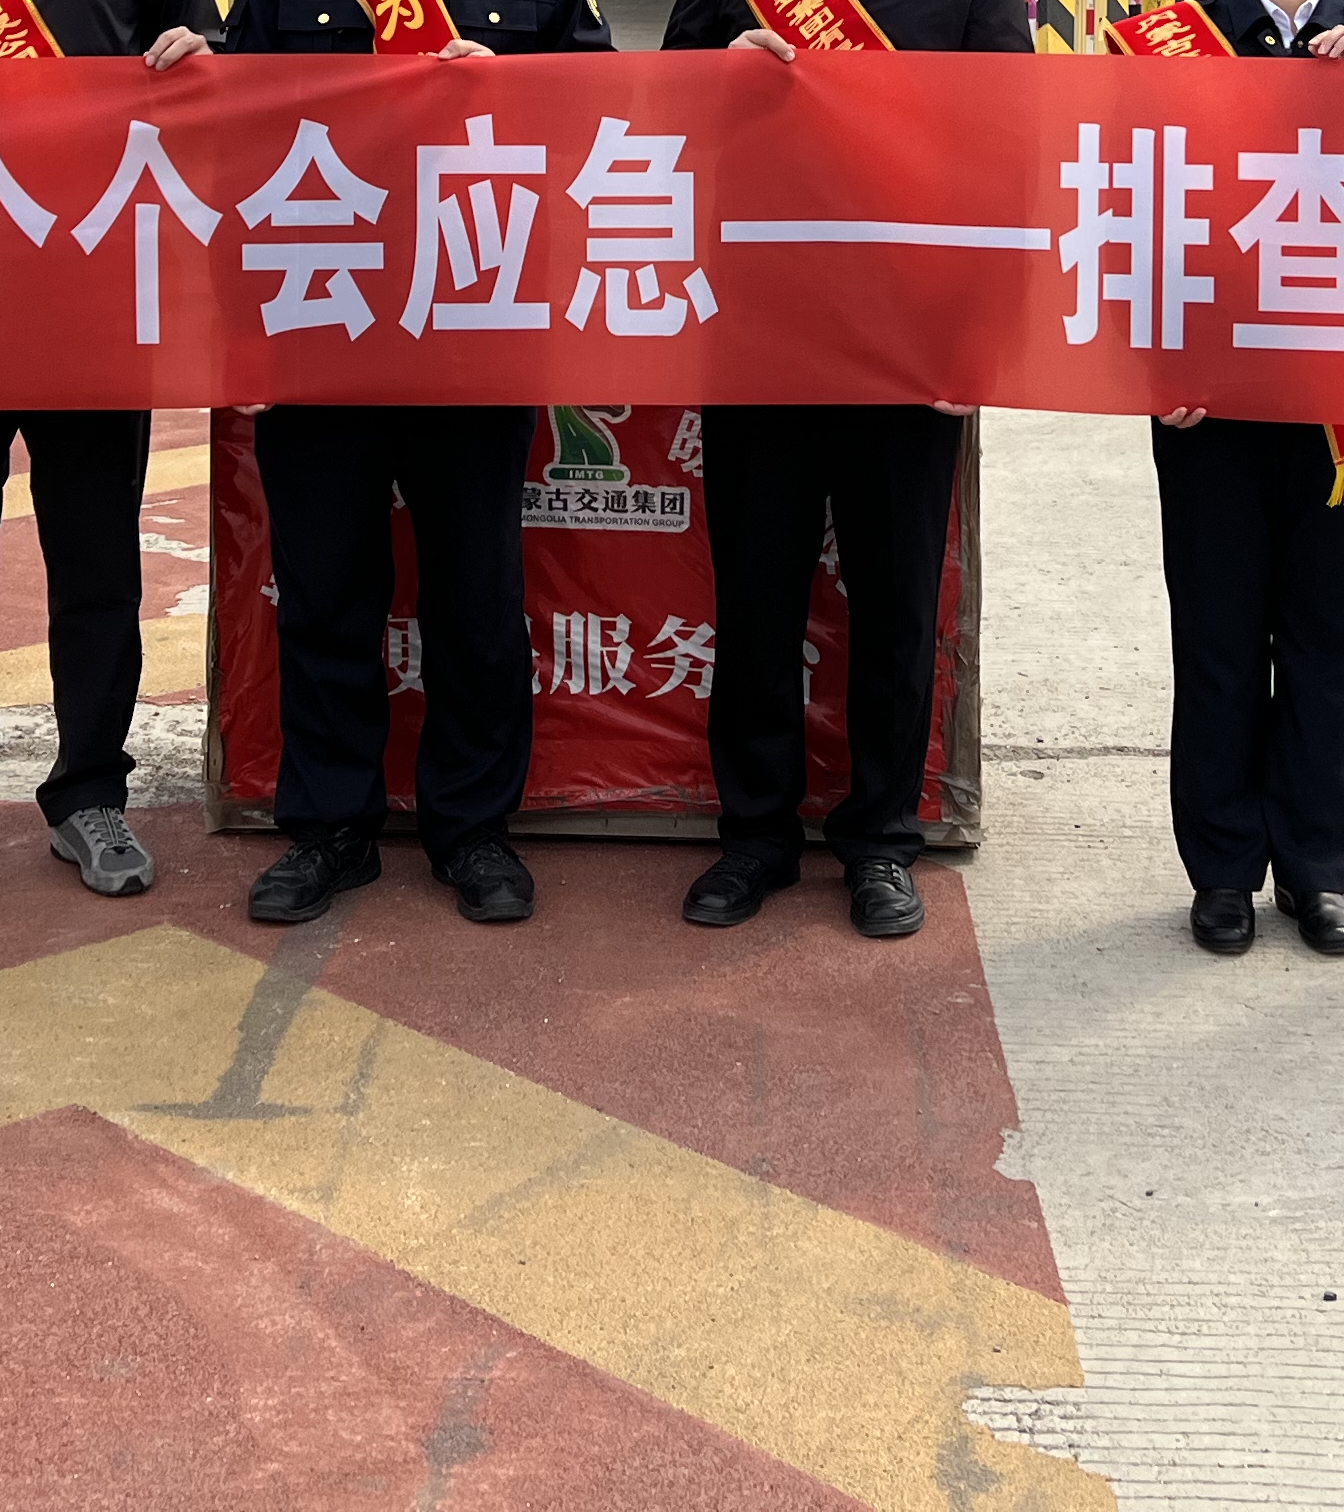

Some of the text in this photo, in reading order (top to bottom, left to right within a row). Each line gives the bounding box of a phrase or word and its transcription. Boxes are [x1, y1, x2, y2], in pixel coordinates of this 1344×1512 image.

[1136, 10, 1211, 57] 内蒙古
[568, 470, 605, 480] IMTG
[568, 514, 650, 526] TRANSPORTATION
[652, 518, 685, 528] GROUP
